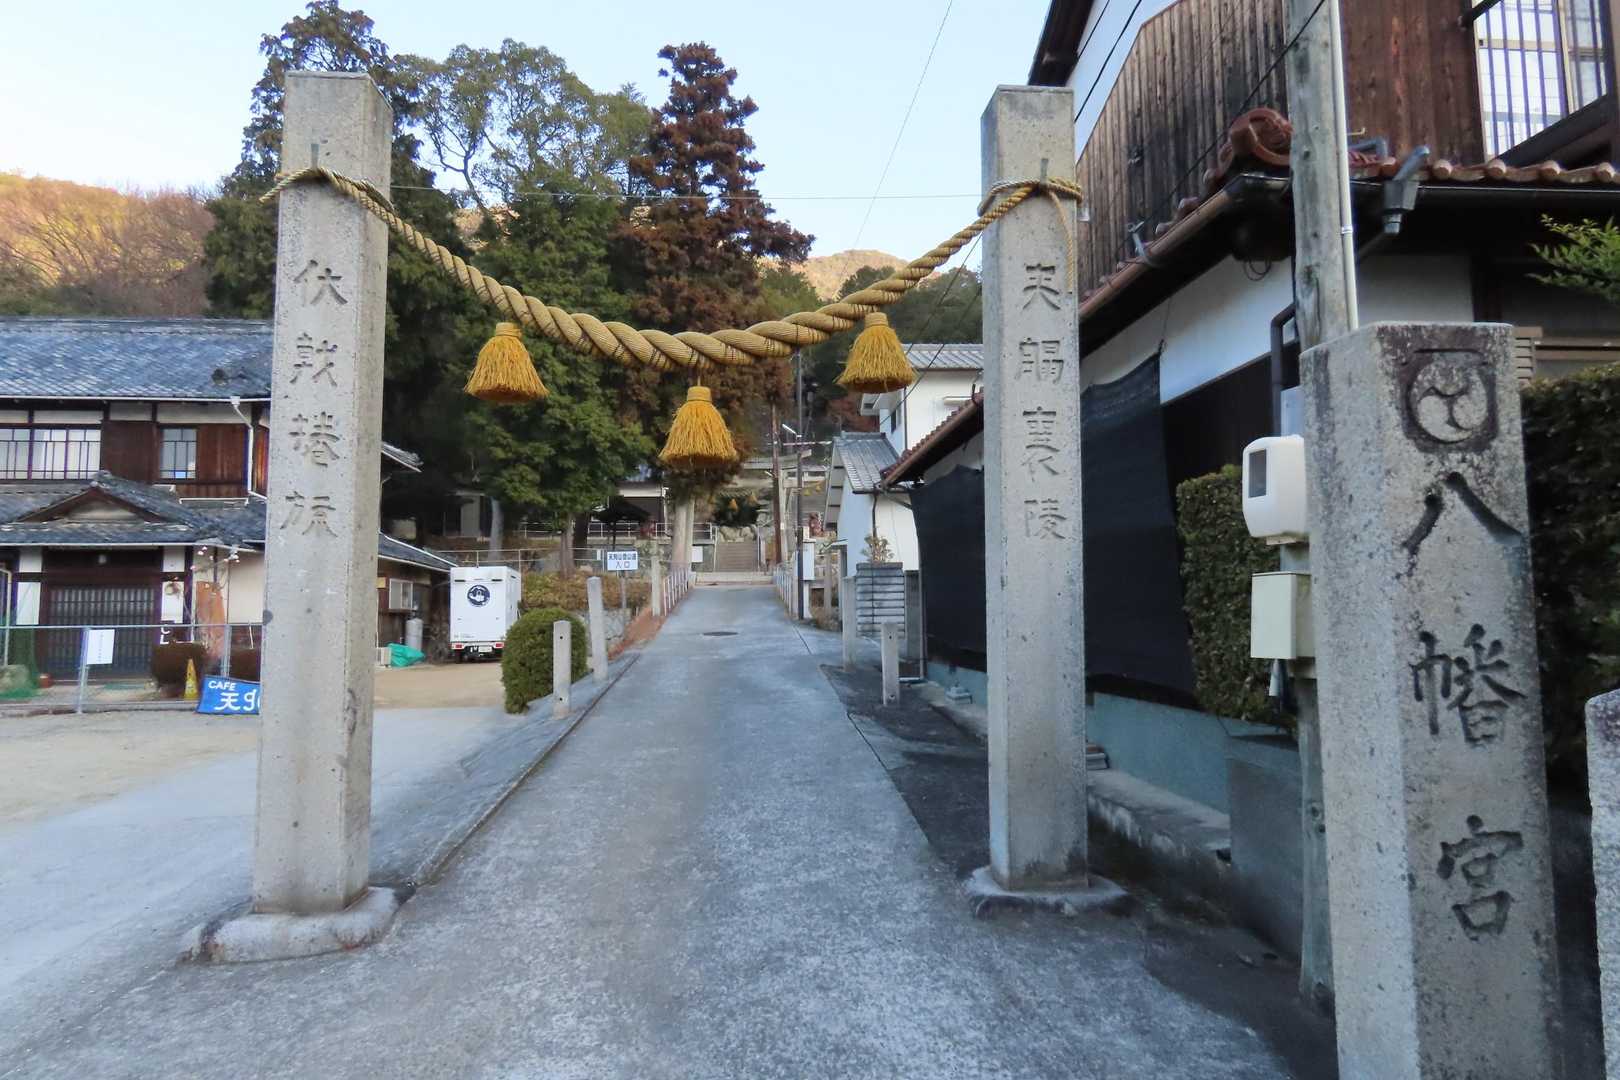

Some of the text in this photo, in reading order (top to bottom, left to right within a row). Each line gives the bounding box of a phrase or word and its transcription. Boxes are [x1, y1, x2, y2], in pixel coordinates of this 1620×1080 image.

[208, 680, 236, 691] CAFE
[213, 688, 260, 711] 天g
[1400, 470, 1527, 938] 八幡宮
